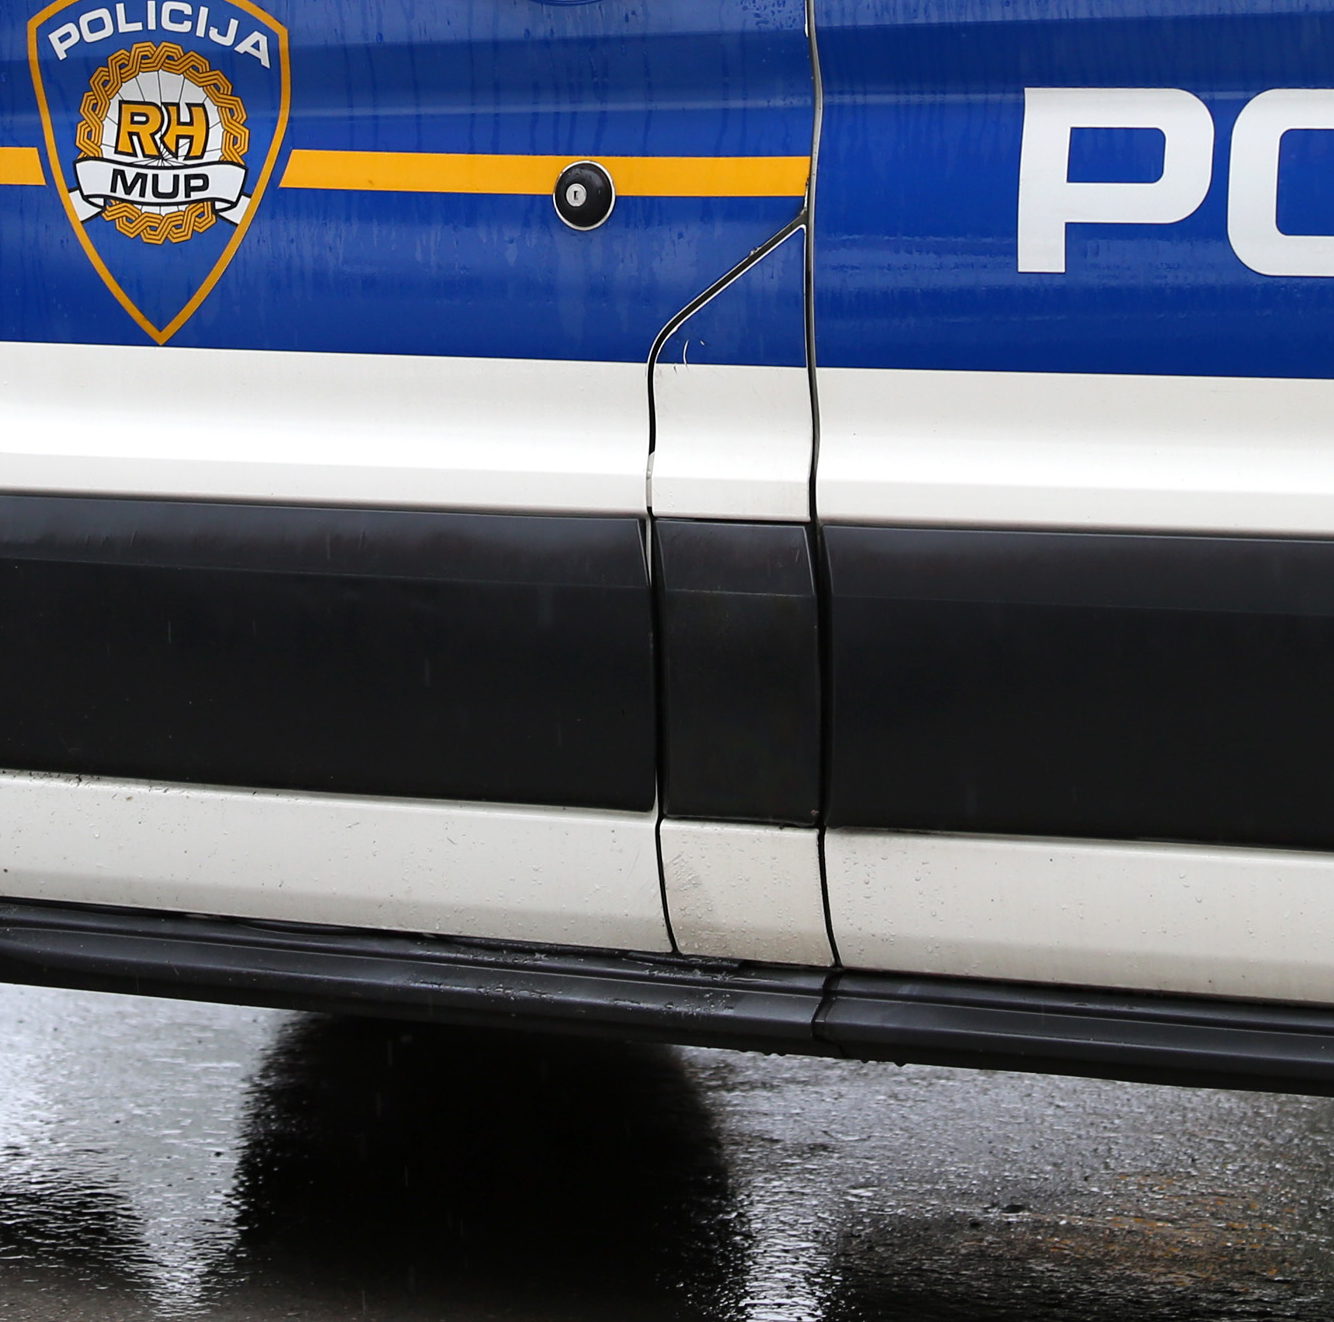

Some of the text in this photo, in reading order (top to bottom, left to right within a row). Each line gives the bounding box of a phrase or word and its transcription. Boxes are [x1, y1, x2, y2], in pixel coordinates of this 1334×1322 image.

[48, 0, 271, 69] POLICIJA
[116, 99, 208, 161] RH
[109, 168, 211, 199] MUP
